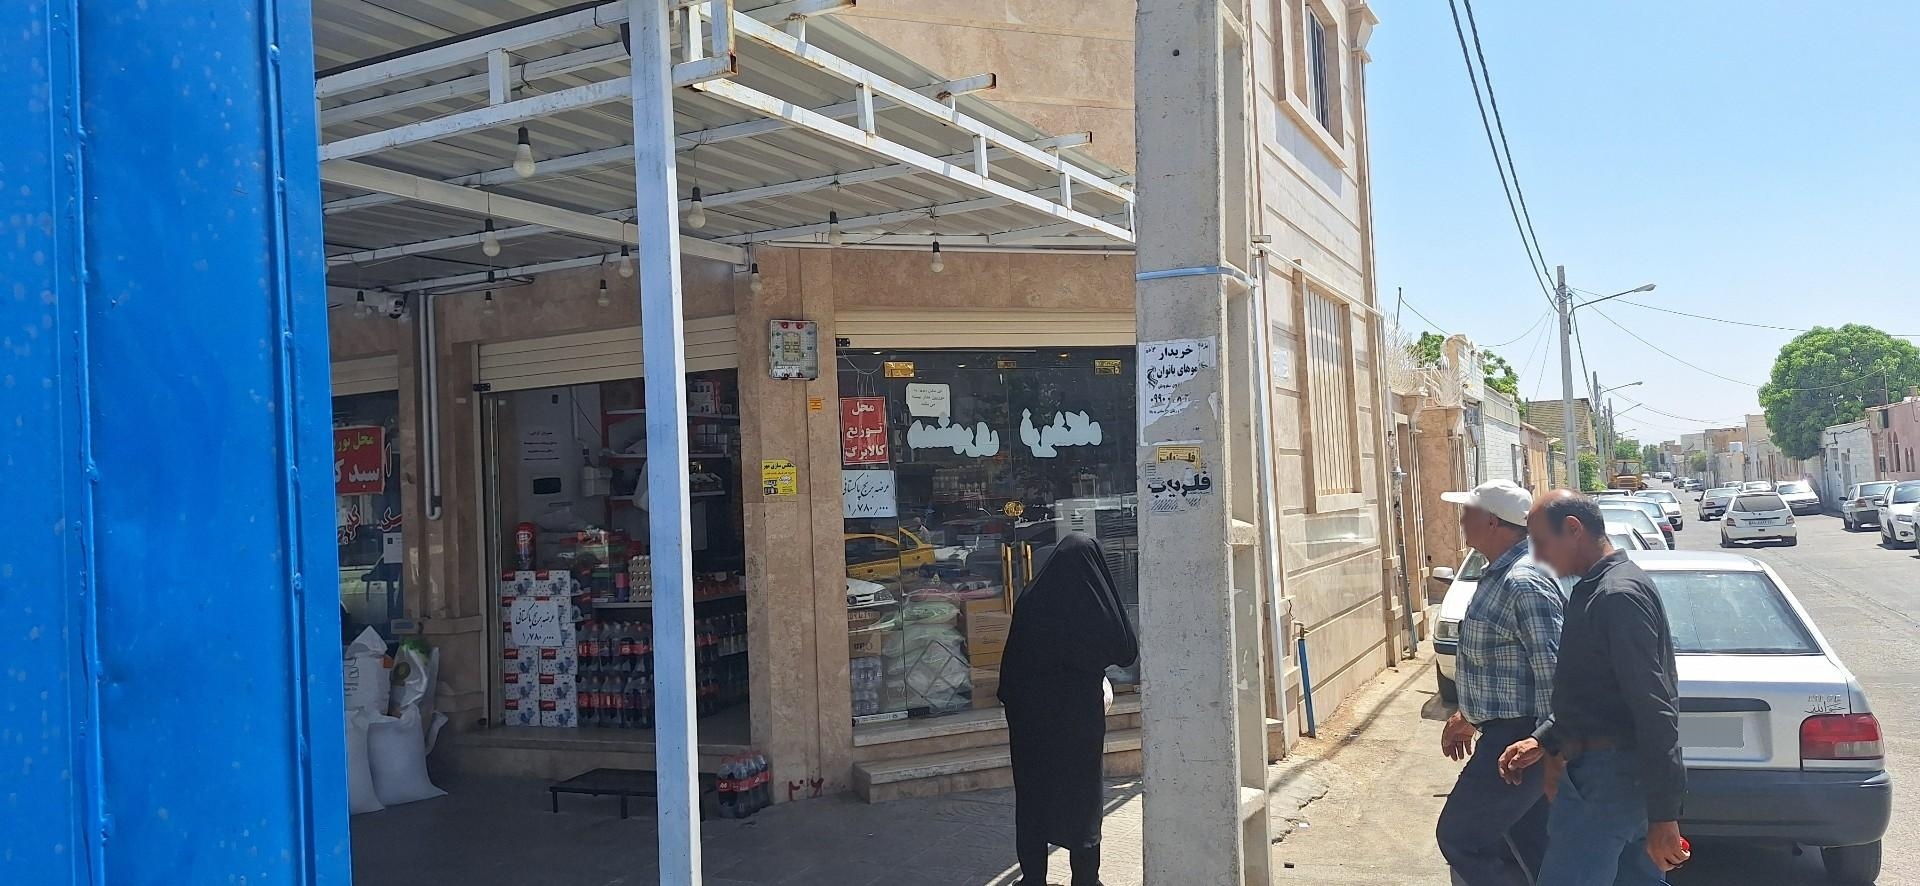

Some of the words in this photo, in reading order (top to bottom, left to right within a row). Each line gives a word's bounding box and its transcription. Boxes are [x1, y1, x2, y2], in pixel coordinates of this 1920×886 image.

[1158, 344, 1193, 360] خریدار
[1156, 363, 1176, 378] بانوان
[1177, 363, 1198, 377] موهای
[852, 401, 875, 416] محل
[846, 422, 883, 440] توزیع
[353, 432, 375, 450] محل
[845, 444, 886, 460] کالابرگ
[348, 464, 380, 489] سبد
